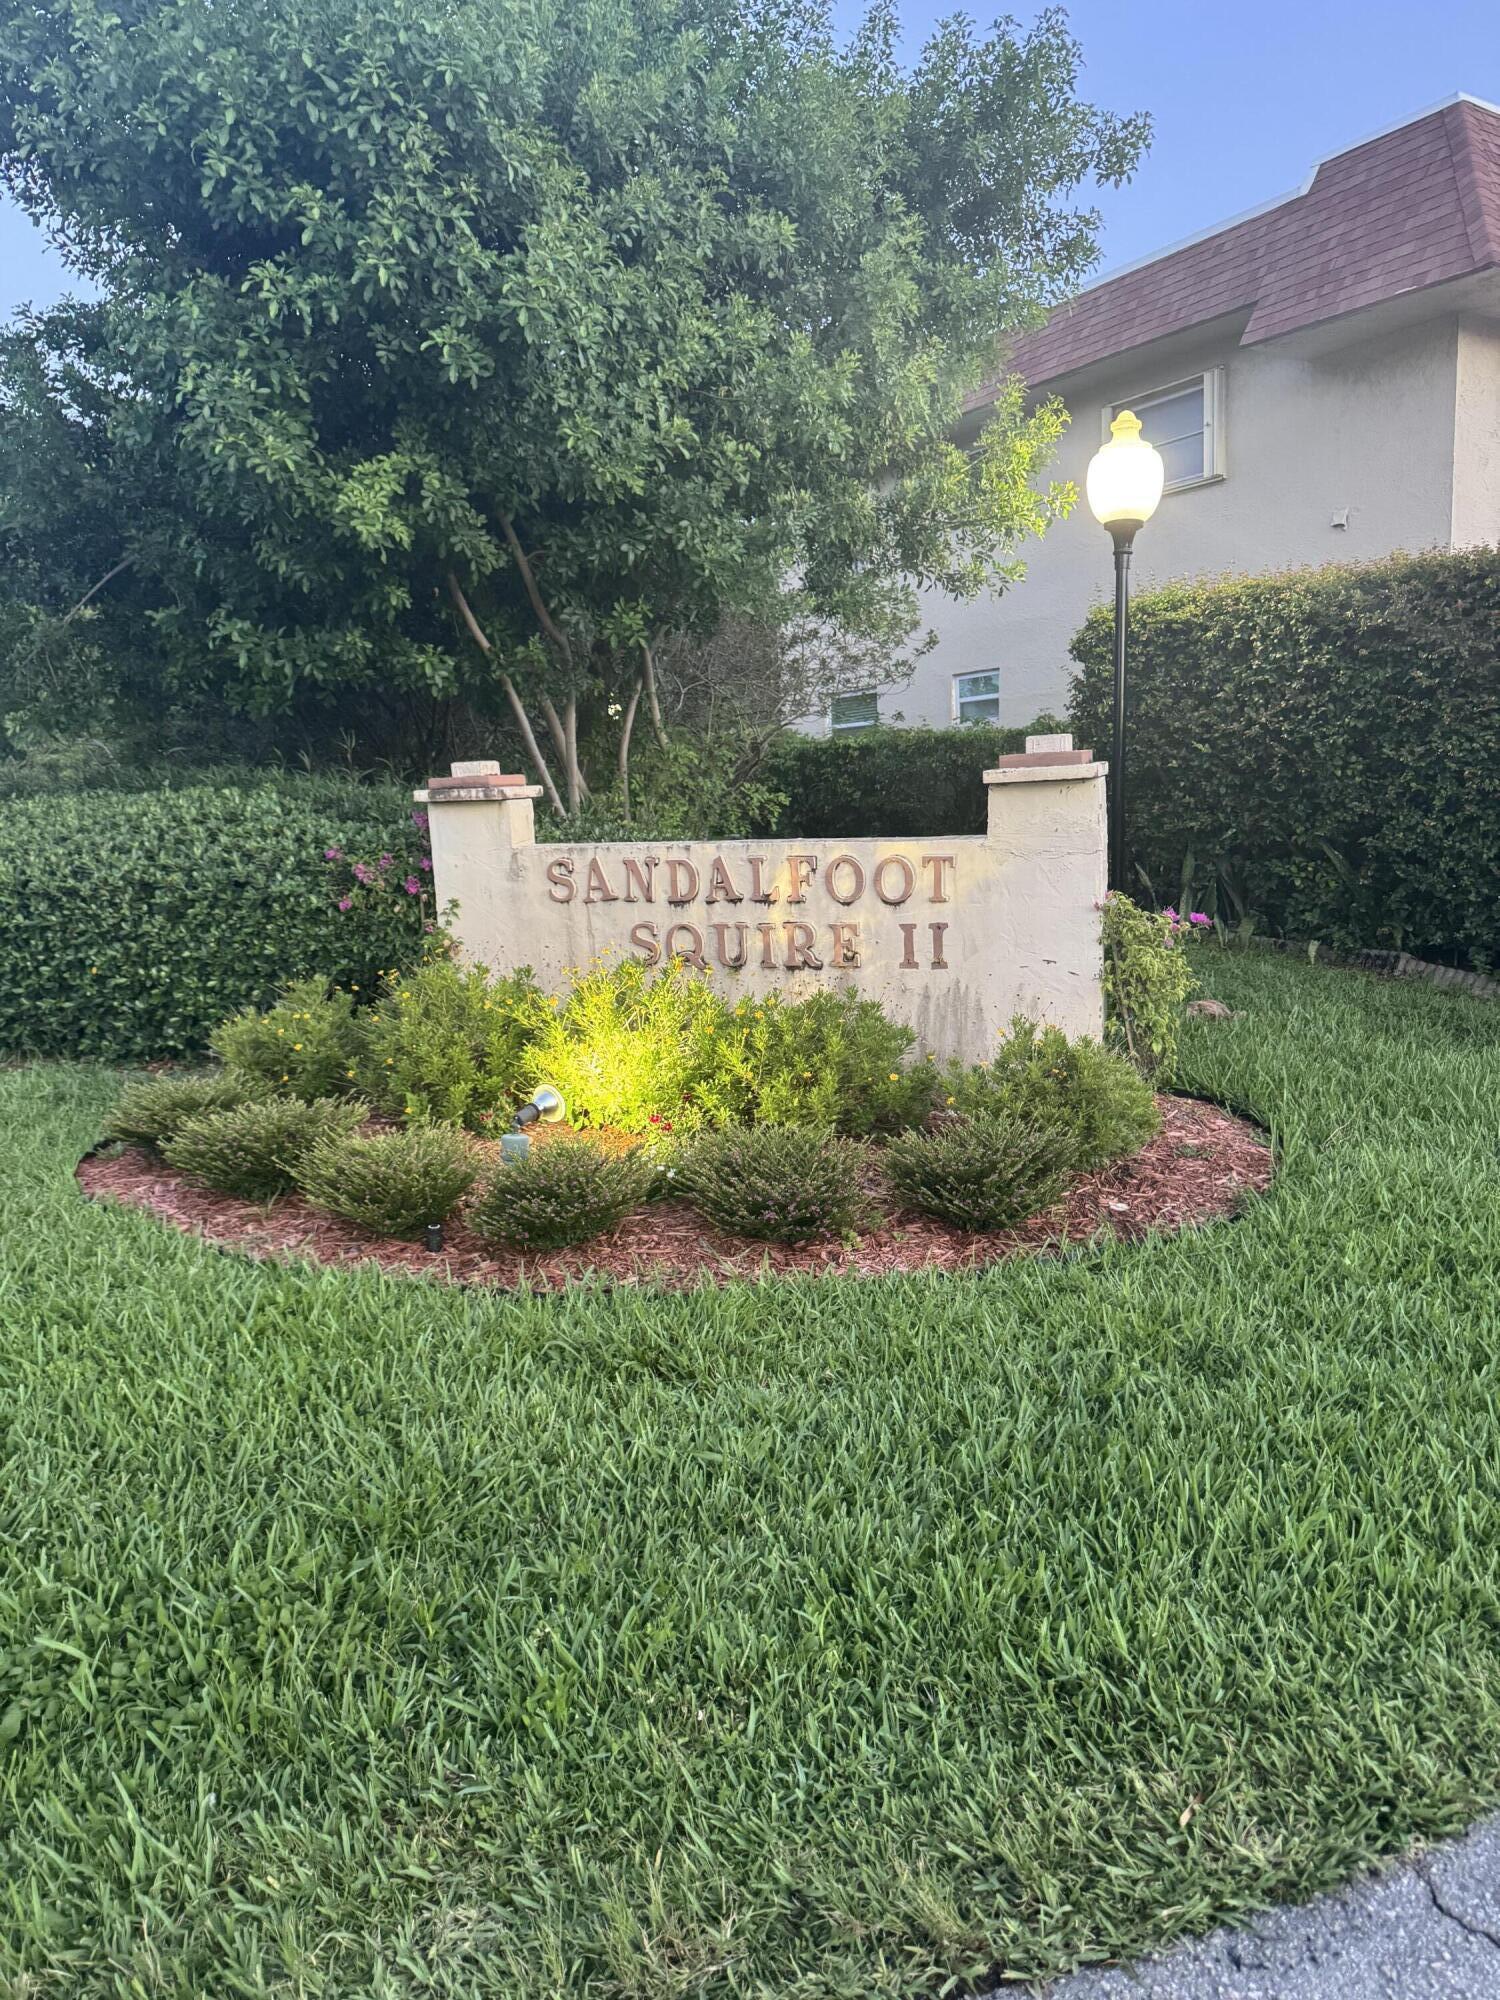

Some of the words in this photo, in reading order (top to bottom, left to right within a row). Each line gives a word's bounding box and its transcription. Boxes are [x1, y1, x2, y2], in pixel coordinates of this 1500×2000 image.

[547, 855, 956, 903] SANDALFOOT
[631, 922, 861, 969] SQUIRE
[899, 922, 949, 969] II
